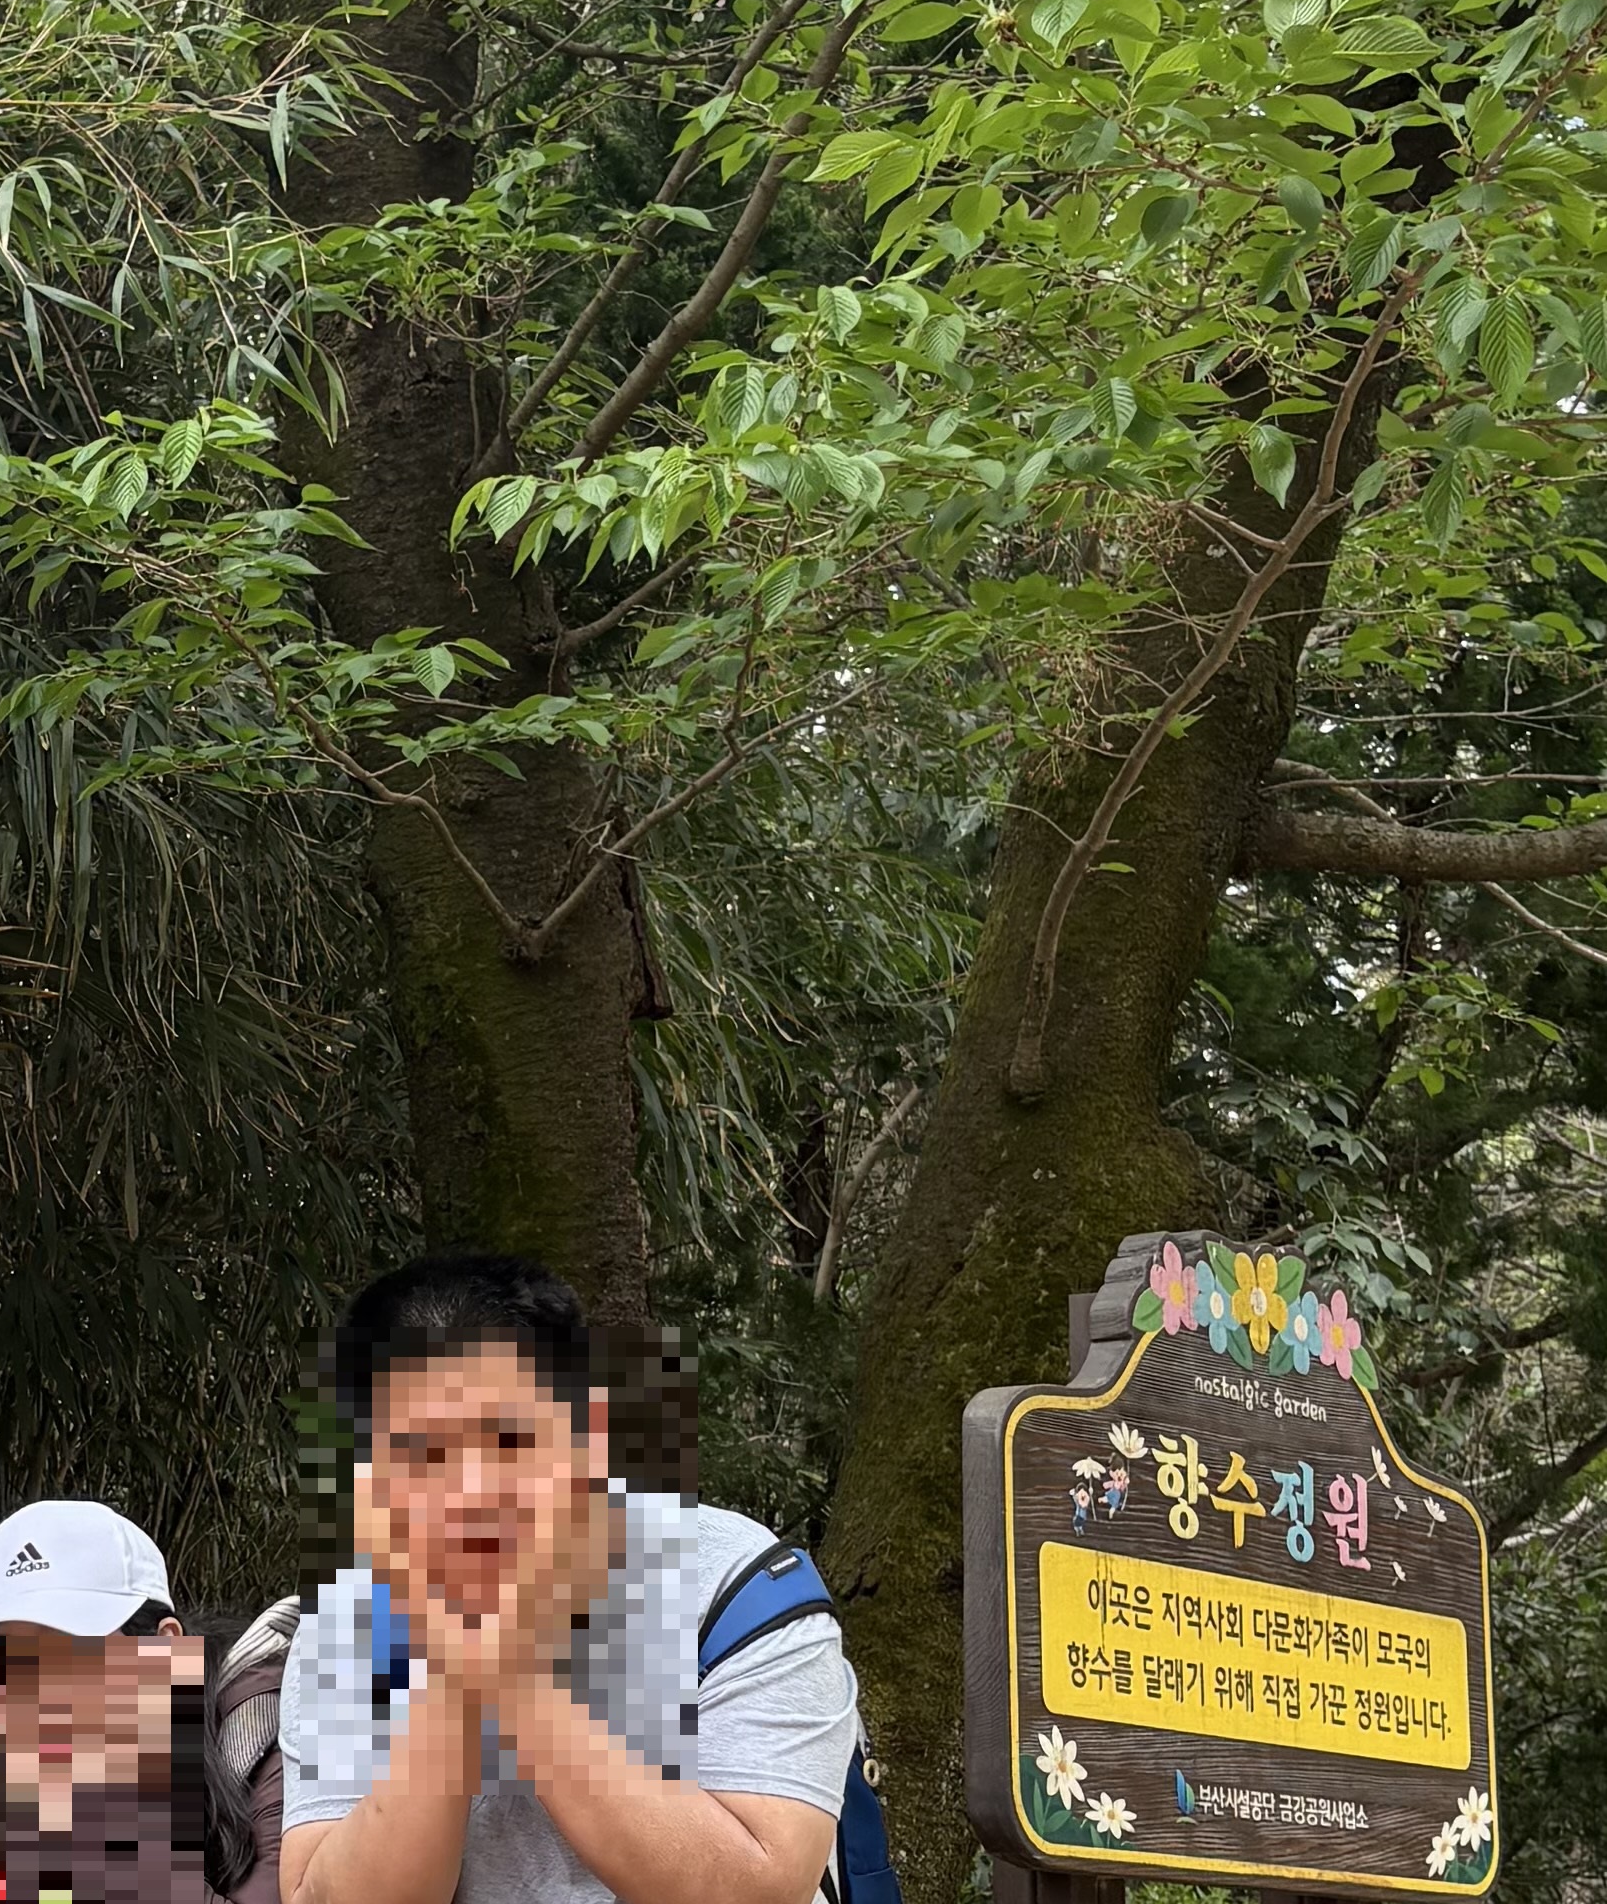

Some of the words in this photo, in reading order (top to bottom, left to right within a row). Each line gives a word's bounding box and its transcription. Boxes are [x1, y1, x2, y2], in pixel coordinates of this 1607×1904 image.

[1195, 1376, 1270, 1411] nostalgic
[1274, 1387, 1327, 1422] garden
[1152, 1433, 1372, 1571] 향수정원
[6, 1561, 50, 1577] adidas
[1088, 1578, 1153, 1631] 이곳은
[1162, 1592, 1244, 1647] 지역사회
[1253, 1609, 1369, 1667] 다문화가족이
[1376, 1630, 1431, 1678] 모국의
[1067, 1641, 1134, 1695] 향수를
[1143, 1654, 1205, 1707] 달래기
[1214, 1666, 1254, 1713] 위해
[1262, 1674, 1301, 1720] 직접
[1310, 1682, 1347, 1726] 가꾼
[1354, 1689, 1451, 1741] 정원입니다.
[1196, 1784, 1275, 1821] 부산시설공단
[1278, 1794, 1370, 1830] 금강공원사업소
